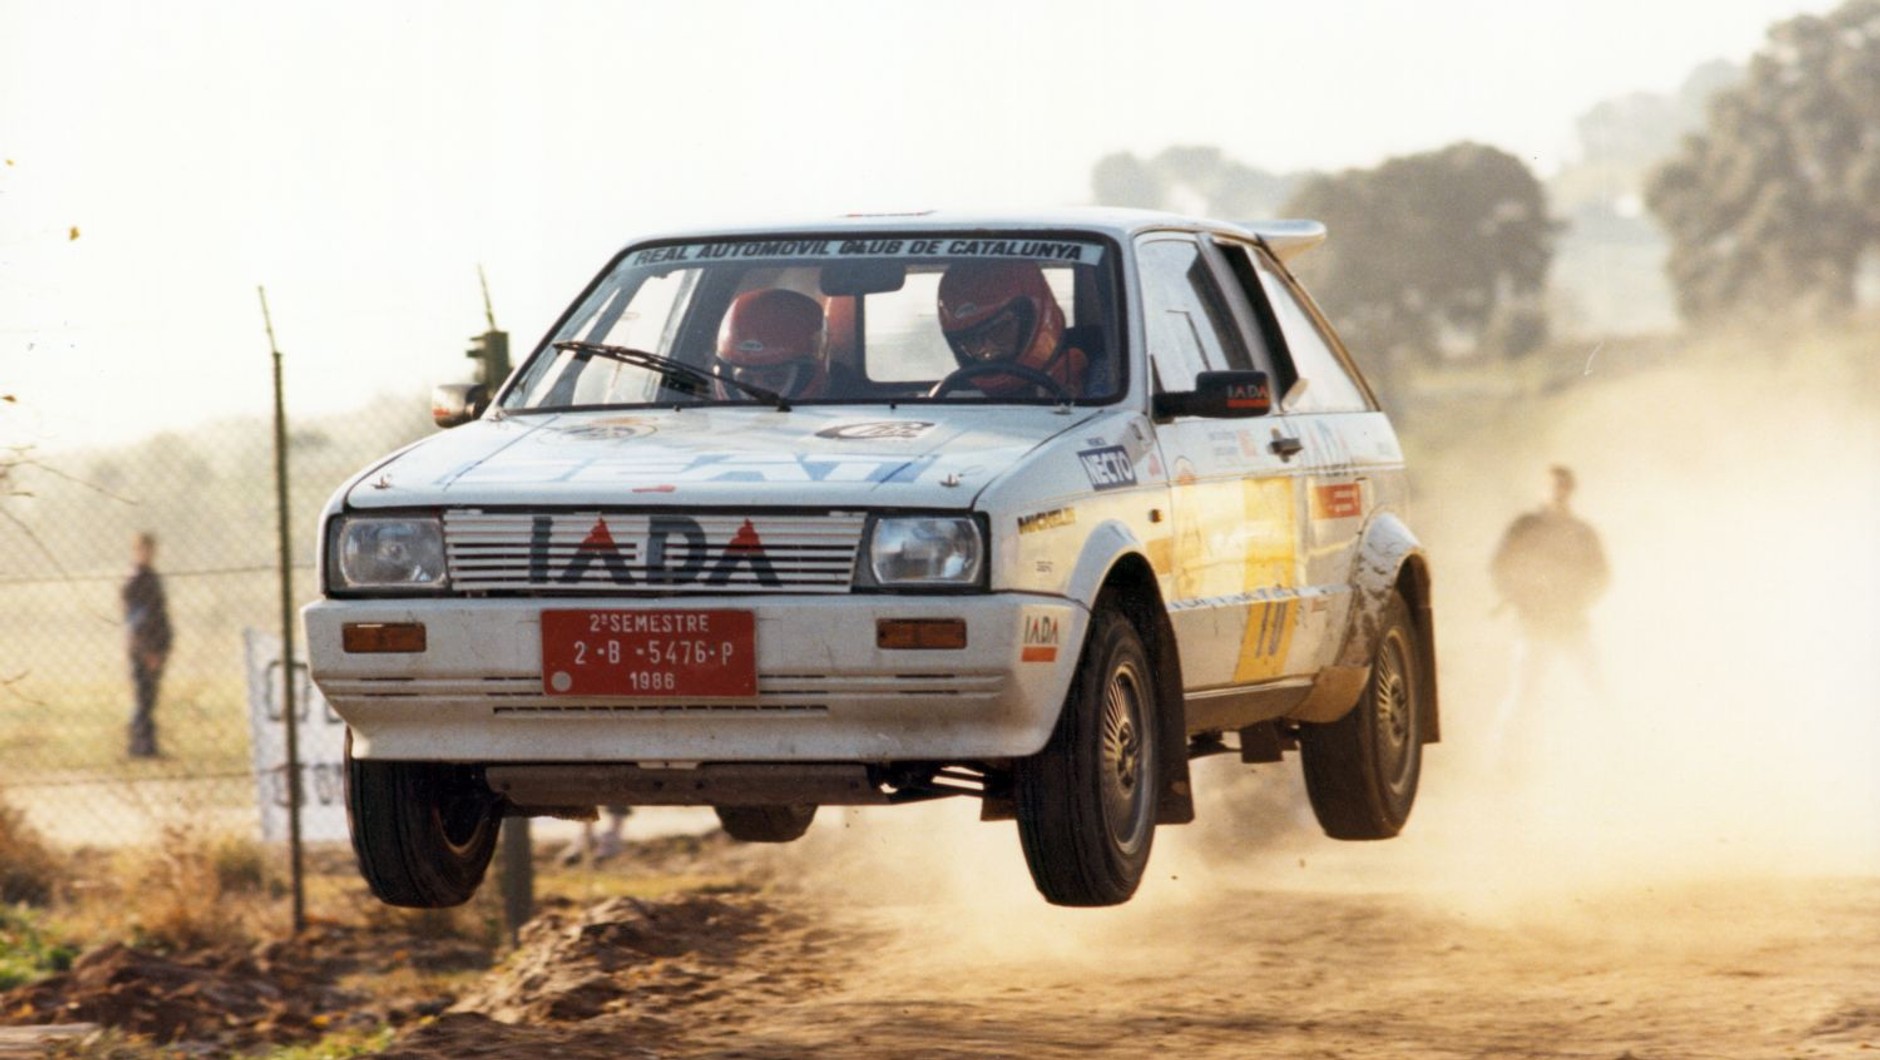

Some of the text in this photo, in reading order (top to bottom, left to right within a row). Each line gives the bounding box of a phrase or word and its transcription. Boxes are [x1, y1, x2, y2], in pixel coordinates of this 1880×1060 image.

[634, 245, 688, 265] REAL
[697, 241, 830, 258] AUTOMOVIL
[908, 239, 944, 254] DE
[947, 241, 1083, 260] CATALUNYA
[1227, 383, 1269, 398] IADA
[1081, 451, 1133, 484] NECTO
[530, 515, 783, 588] IADA
[1024, 614, 1058, 645] IADA
[629, 671, 675, 690] 1986
